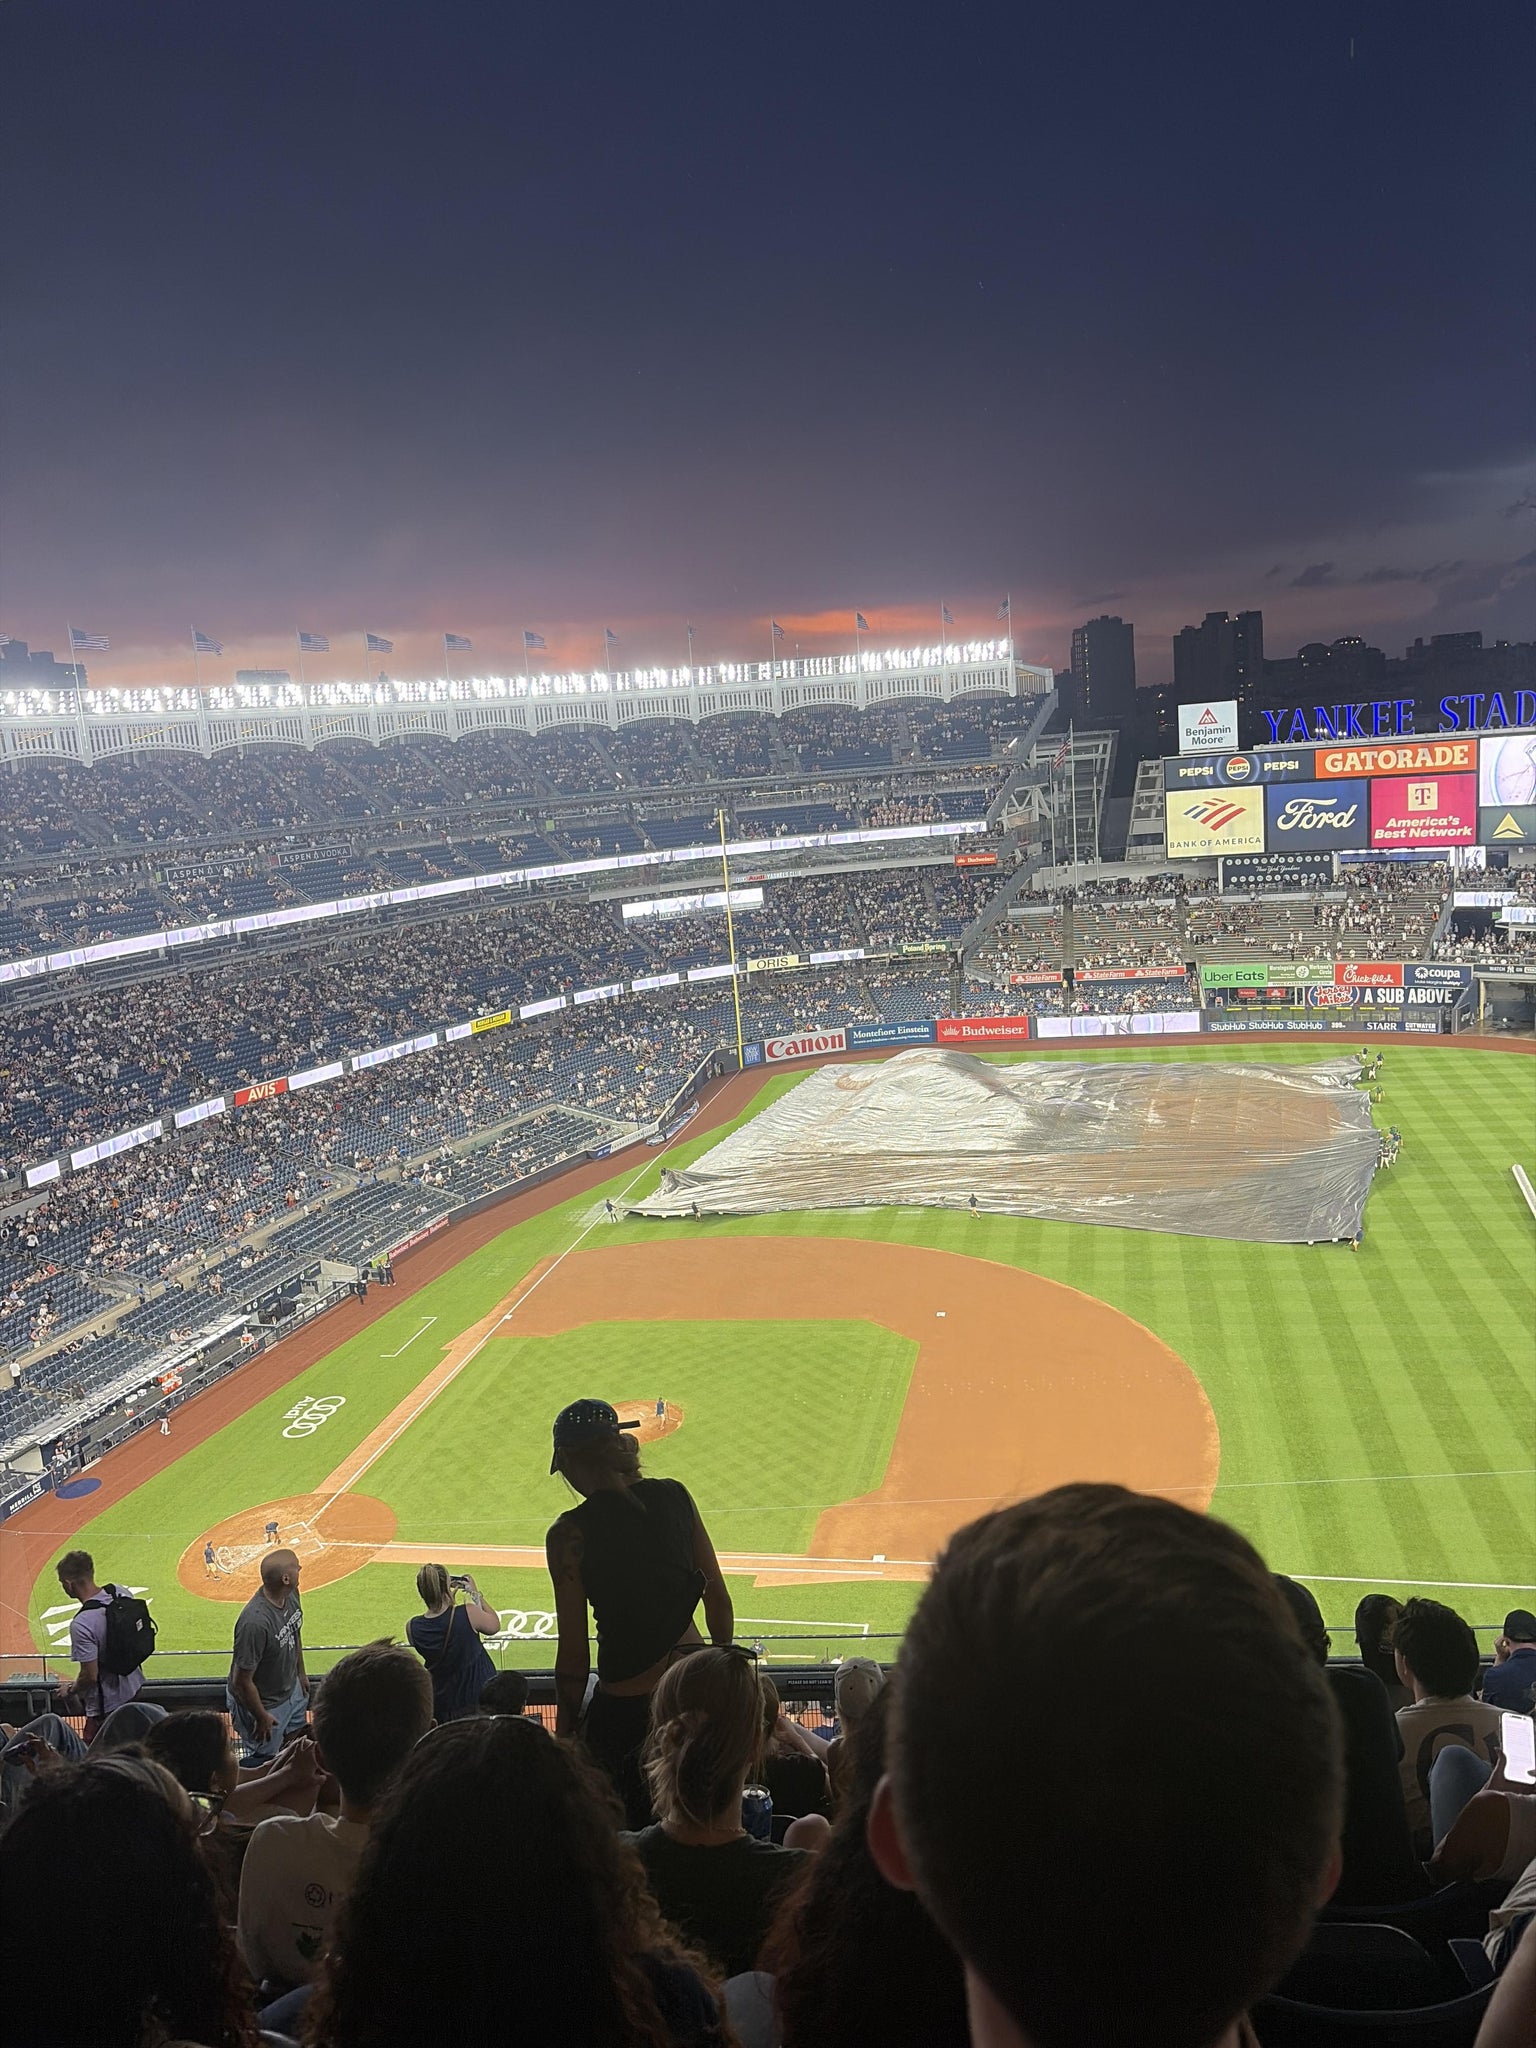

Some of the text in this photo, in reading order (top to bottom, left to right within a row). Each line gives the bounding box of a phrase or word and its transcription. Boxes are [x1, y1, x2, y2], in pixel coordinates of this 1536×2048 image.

[1261, 699, 1415, 744] YANKEE
[1185, 725, 1231, 738] Benjamin
[1191, 735, 1224, 745] Moore
[1263, 760, 1299, 771] PEPSI
[1324, 745, 1468, 773] GATORADE
[1179, 766, 1214, 777] PEPSI
[1276, 798, 1358, 831] Ford
[1386, 815, 1460, 828] America's
[1374, 826, 1472, 839] Best Network
[1170, 836, 1262, 849] BANK OF AMERICA
[283, 847, 348, 864] ASPEN VODKA
[172, 867, 204, 879] ASPEN
[902, 943, 924, 954] Poland
[757, 957, 789, 969] ORIS
[1204, 971, 1265, 982] Uber Eats
[1429, 969, 1461, 980] coupa
[1363, 988, 1453, 1004] A SUB ABOVE
[853, 1025, 930, 1039] Montefiore Einstein
[961, 1025, 1025, 1036] Budweiser
[1211, 1021, 1323, 1031] StubHub StubHub StubHub
[1366, 1022, 1398, 1031] STARR
[766, 1033, 844, 1059] Canon
[248, 1082, 276, 1102] AVIS
[282, 1395, 316, 1419] Audi
[9, 1491, 34, 1511] MERRILL
